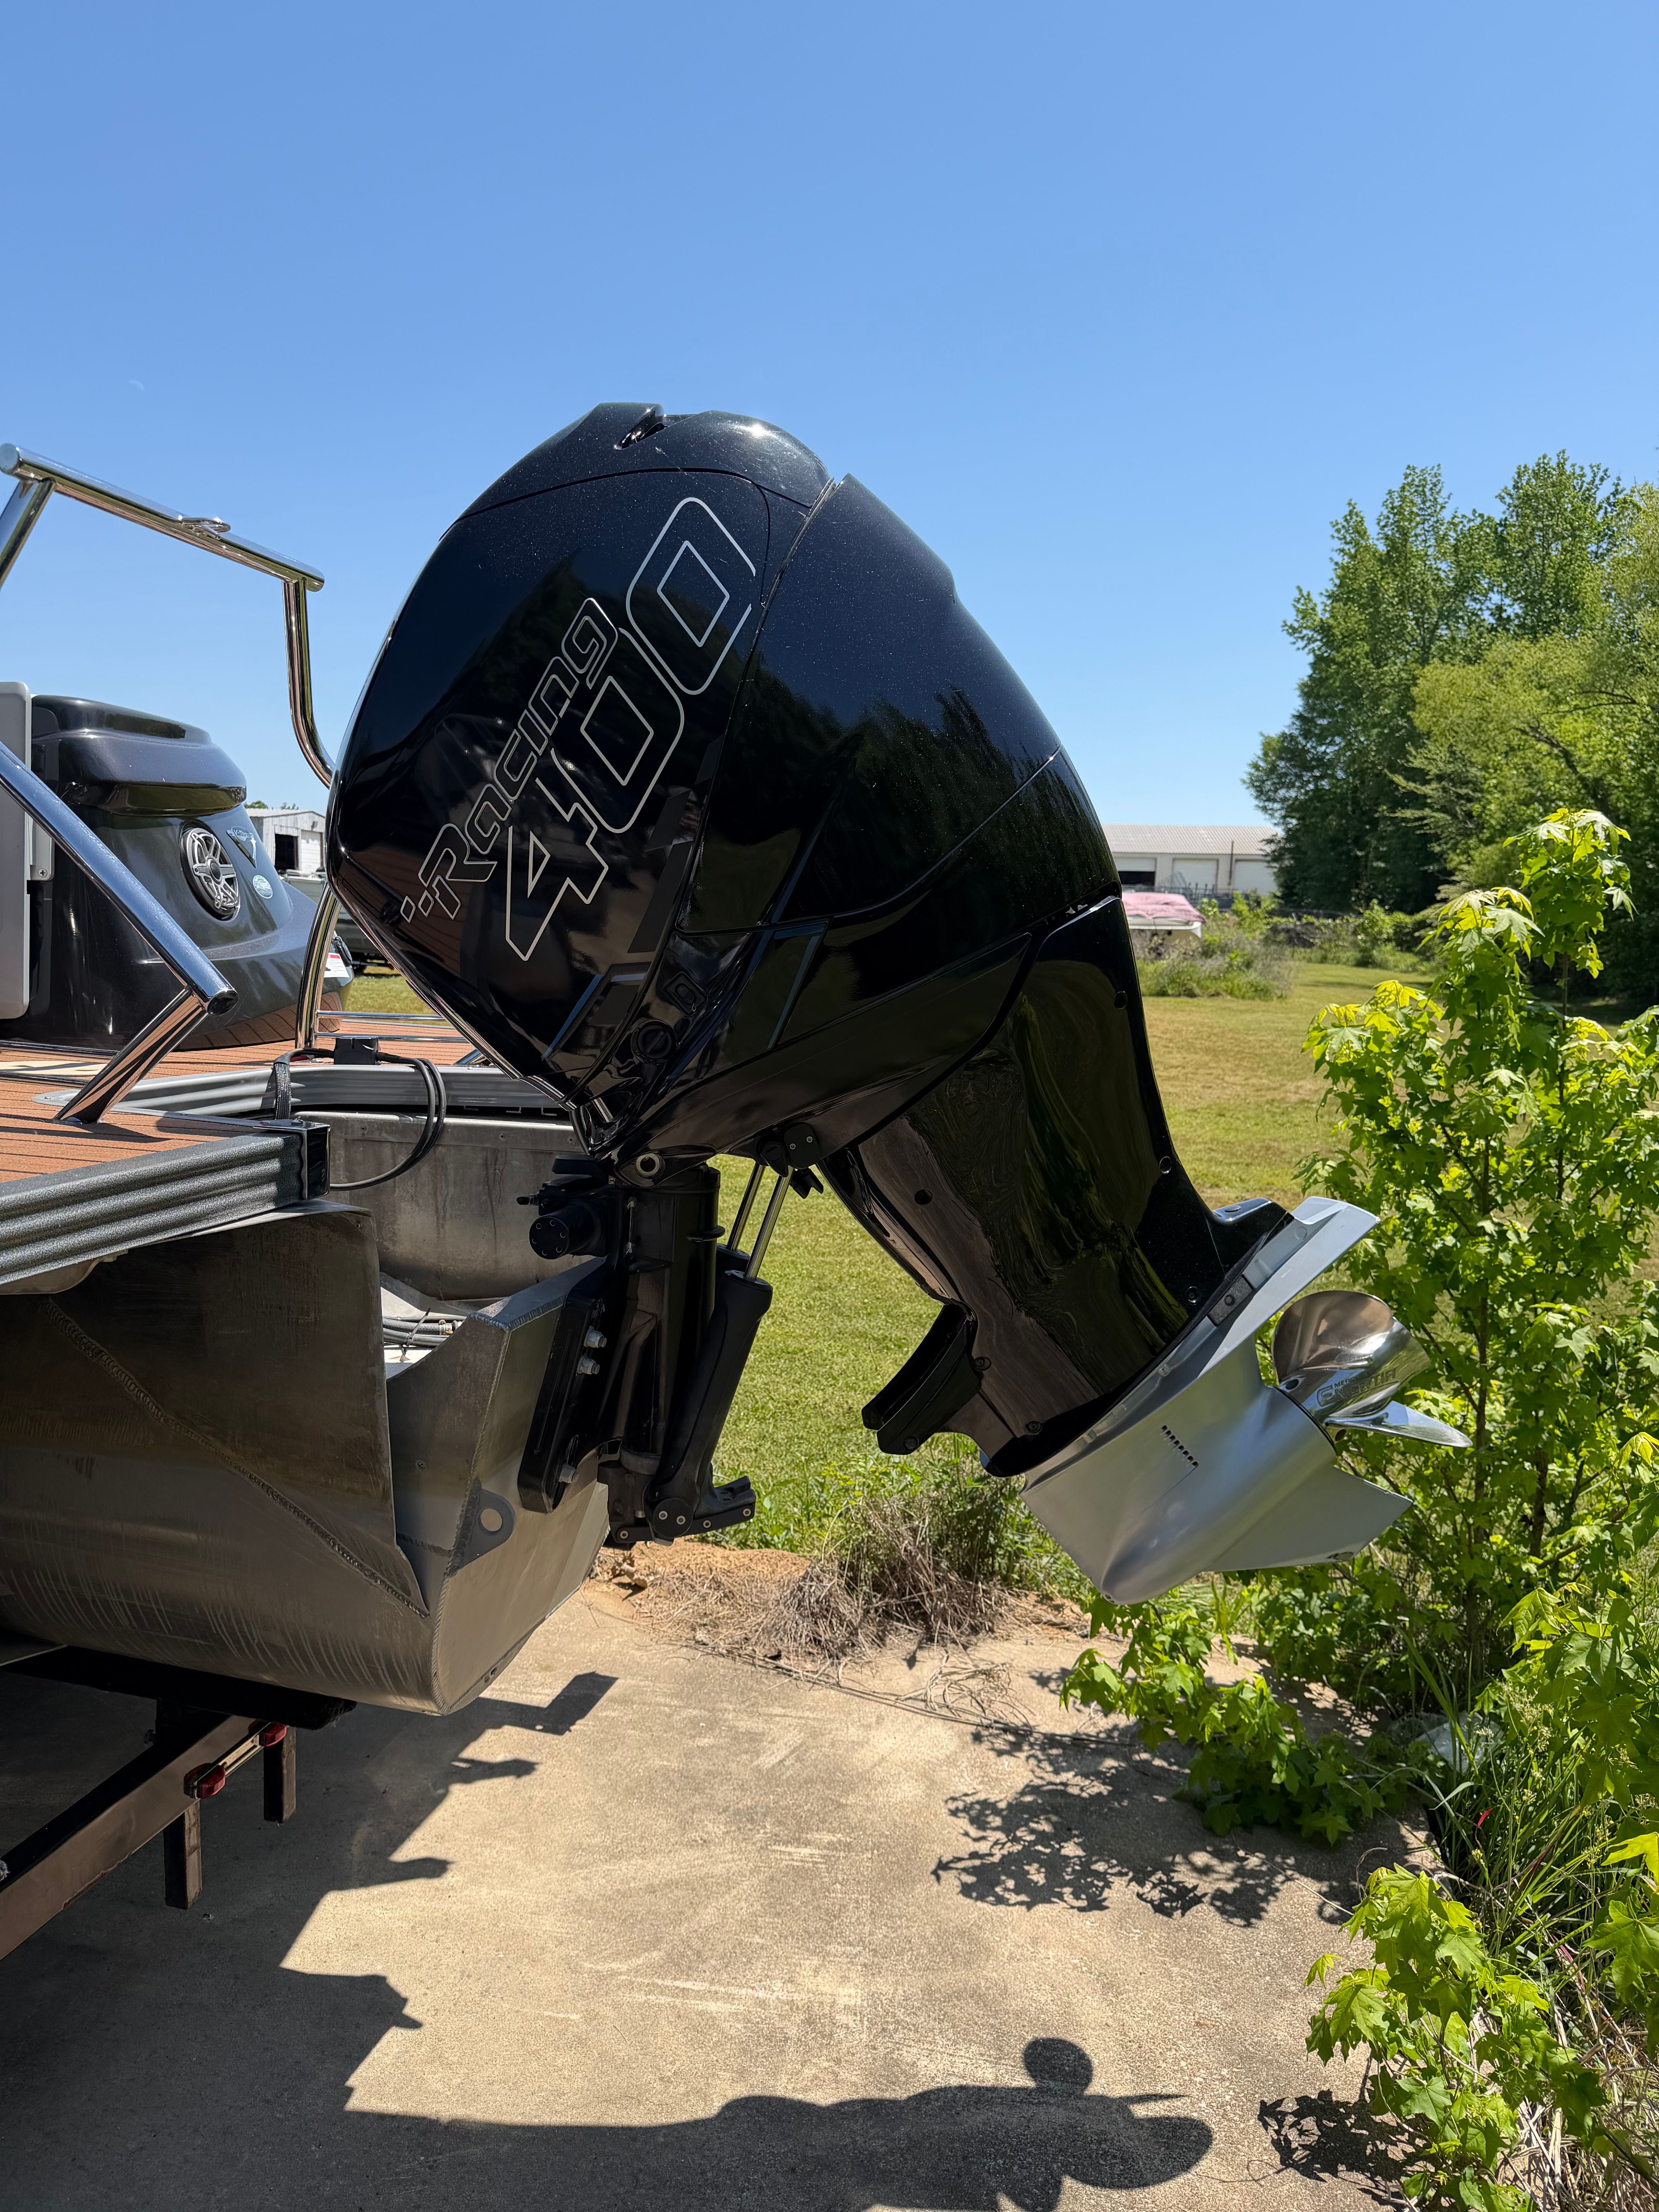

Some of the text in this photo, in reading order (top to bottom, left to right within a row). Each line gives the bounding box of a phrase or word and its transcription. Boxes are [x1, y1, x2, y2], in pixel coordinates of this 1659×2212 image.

[418, 598, 618, 920] Racing
[507, 497, 756, 961] 400
[1334, 1371, 1368, 1388] MERCU
